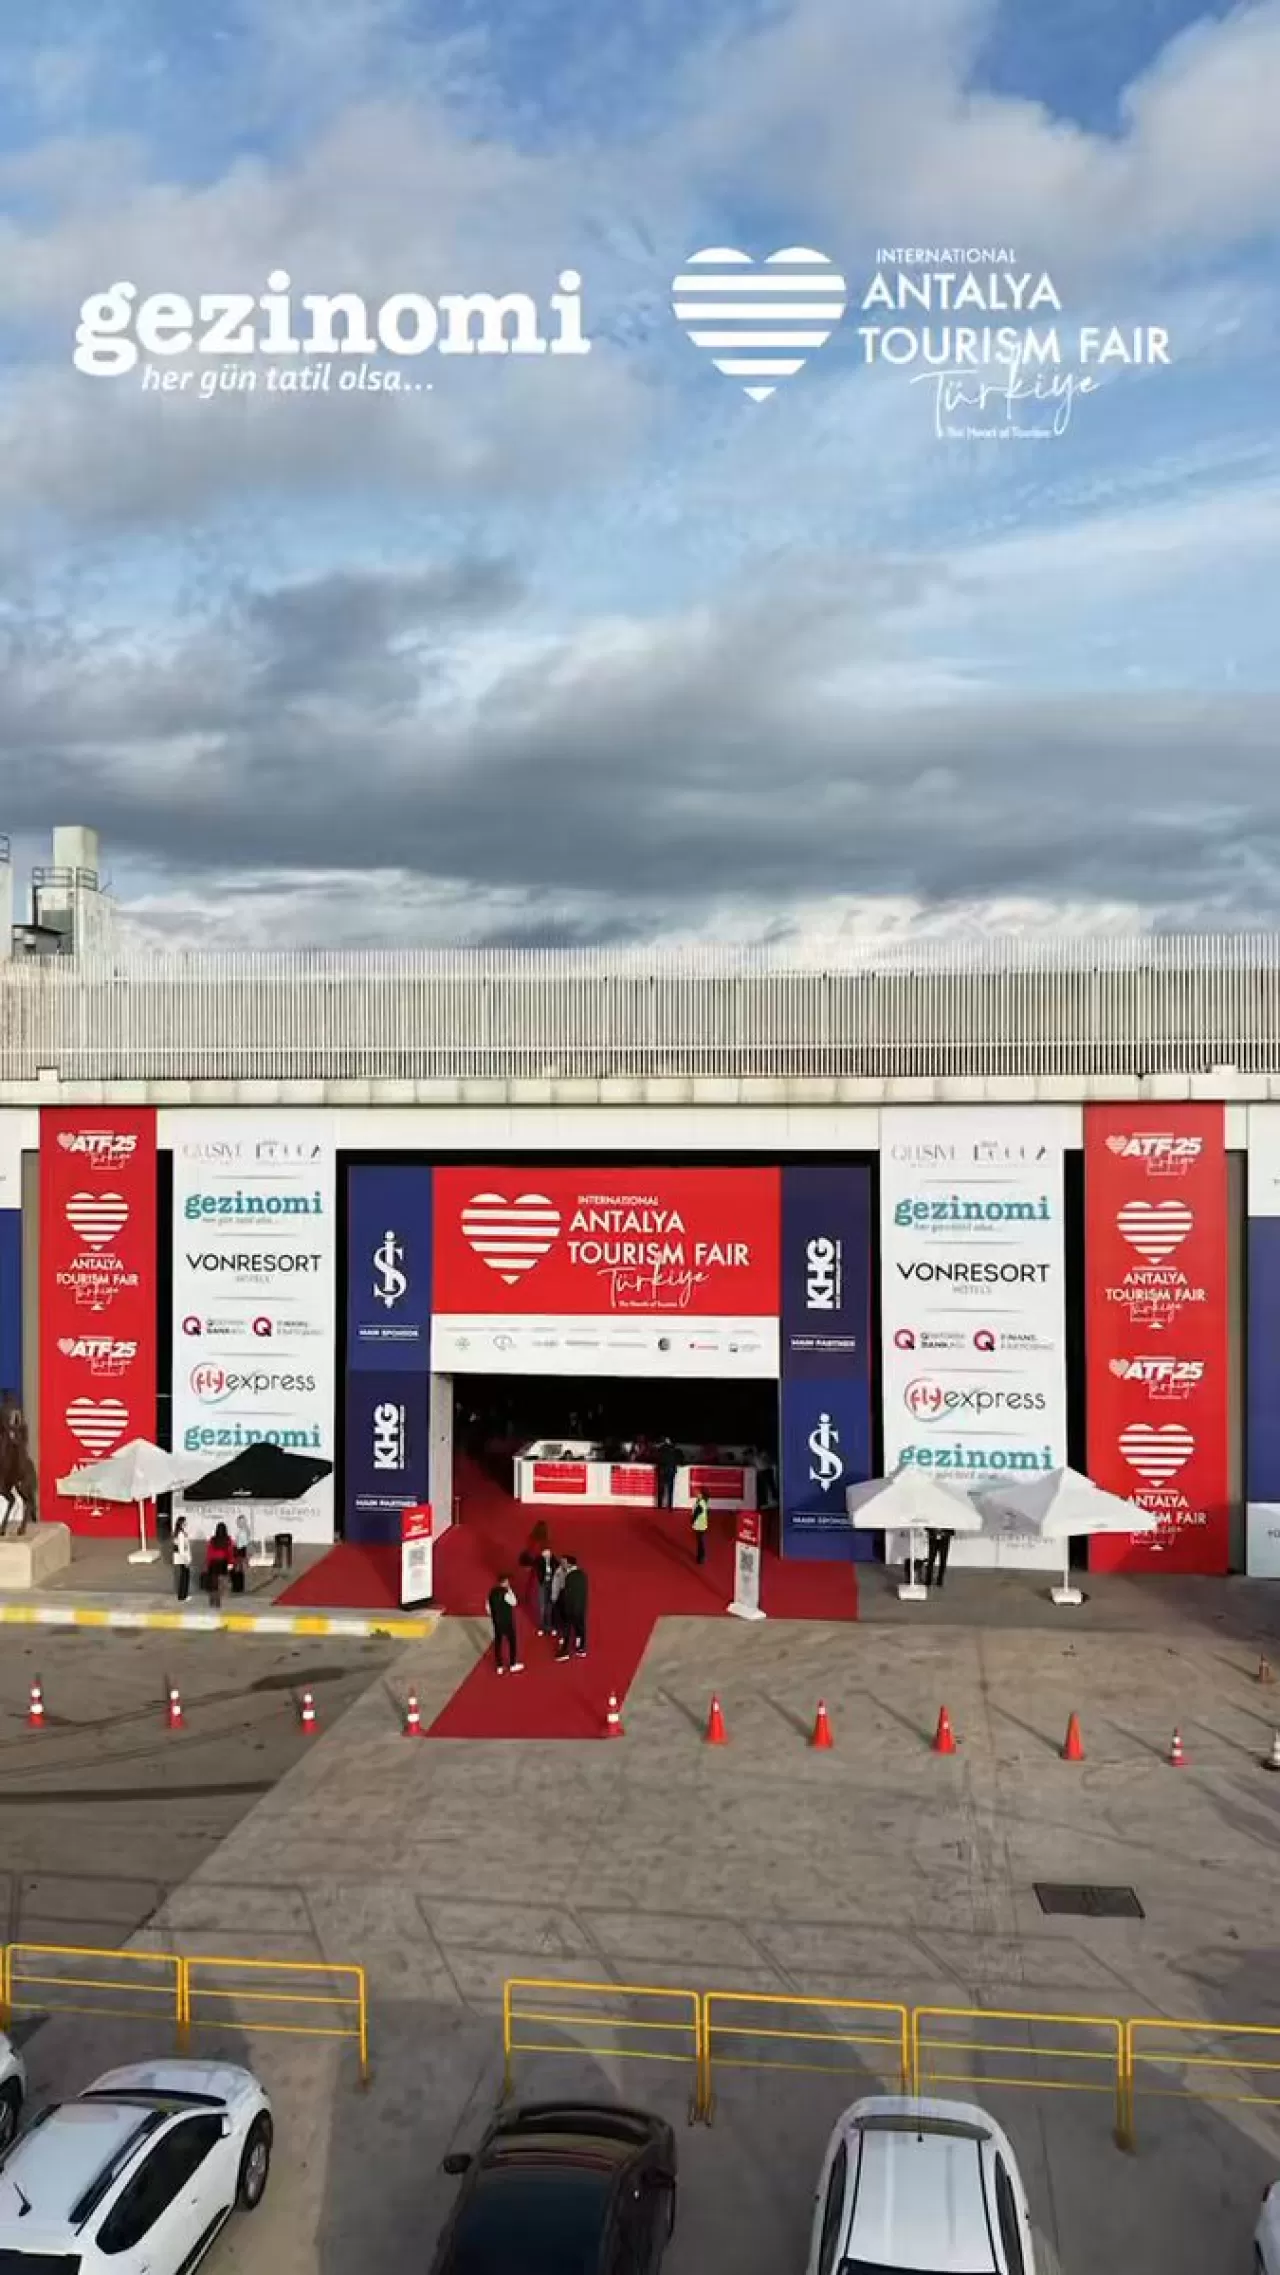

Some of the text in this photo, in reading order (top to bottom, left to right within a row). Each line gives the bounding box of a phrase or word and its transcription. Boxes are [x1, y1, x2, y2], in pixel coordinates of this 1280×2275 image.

[184, 1190, 324, 1220] gezinomi
[894, 1195, 1052, 1226] gezinomi
[569, 1209, 686, 1235] ANTALYA
[185, 1253, 323, 1273] VONRESORT
[567, 1241, 751, 1267] TOURISM FAIR
[806, 1237, 835, 1309] KHG
[896, 1262, 1052, 1283] VONRESORT
[1122, 1271, 1188, 1285] ANTALYA
[1105, 1288, 1206, 1302] TOURISM FAIR
[184, 1422, 322, 1451] gezinomi
[373, 1402, 400, 1469] KHG
[1176, 1512, 1207, 1525] FAIR
